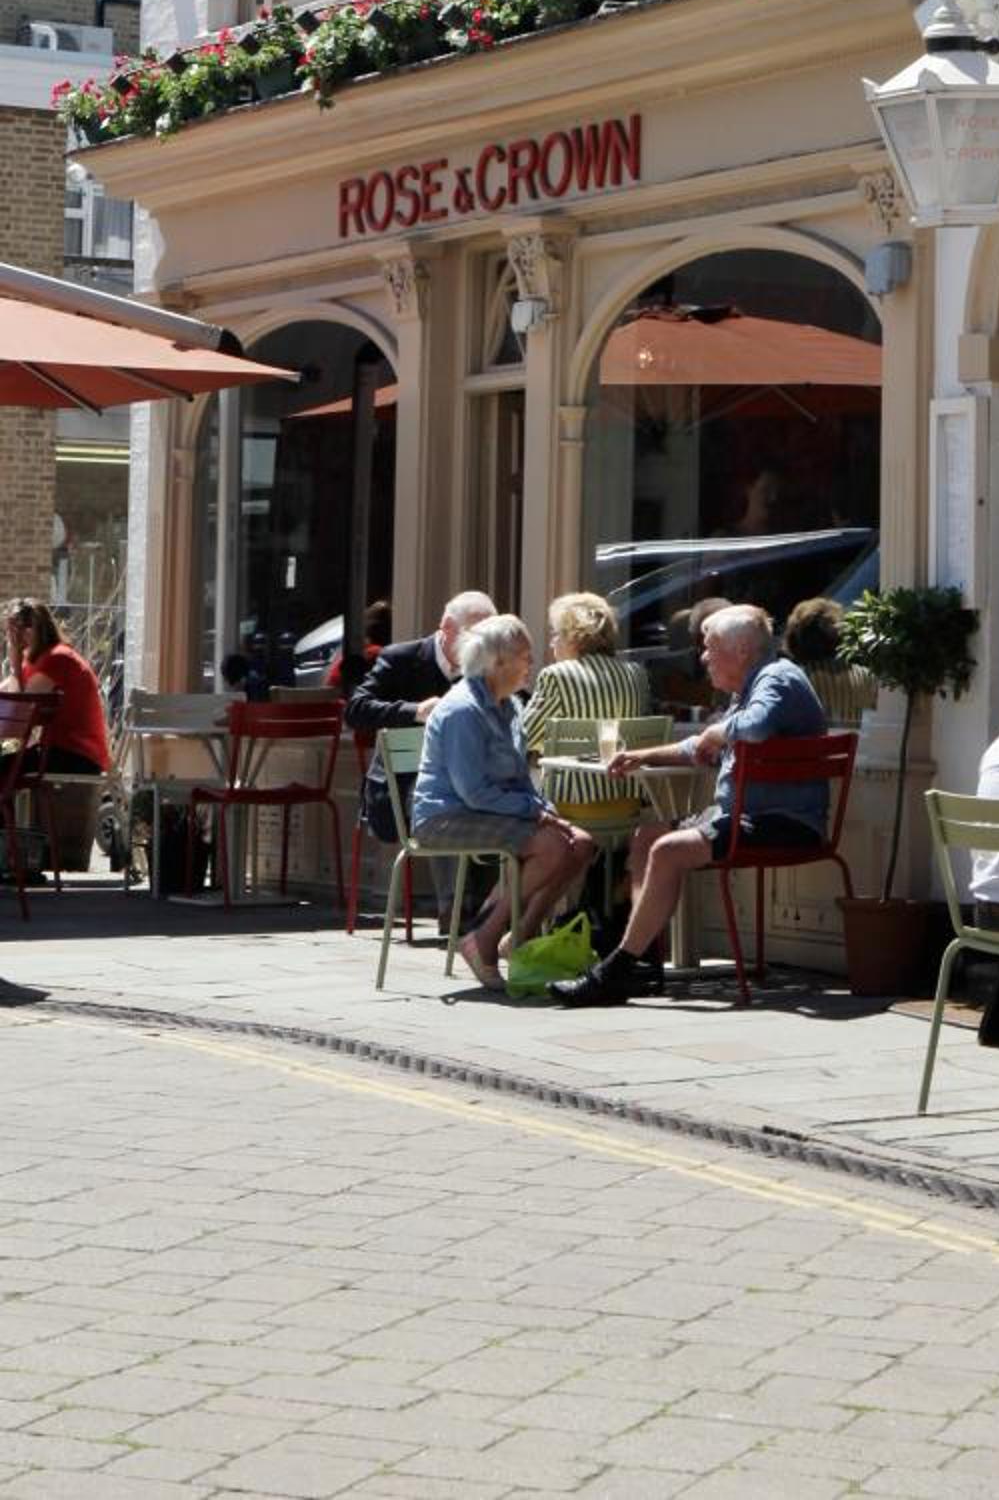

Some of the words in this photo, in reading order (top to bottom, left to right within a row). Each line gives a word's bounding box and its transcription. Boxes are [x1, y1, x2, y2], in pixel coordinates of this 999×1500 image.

[339, 158, 448, 238] ROSE
[453, 167, 474, 214] &
[475, 113, 642, 212] CROWN
